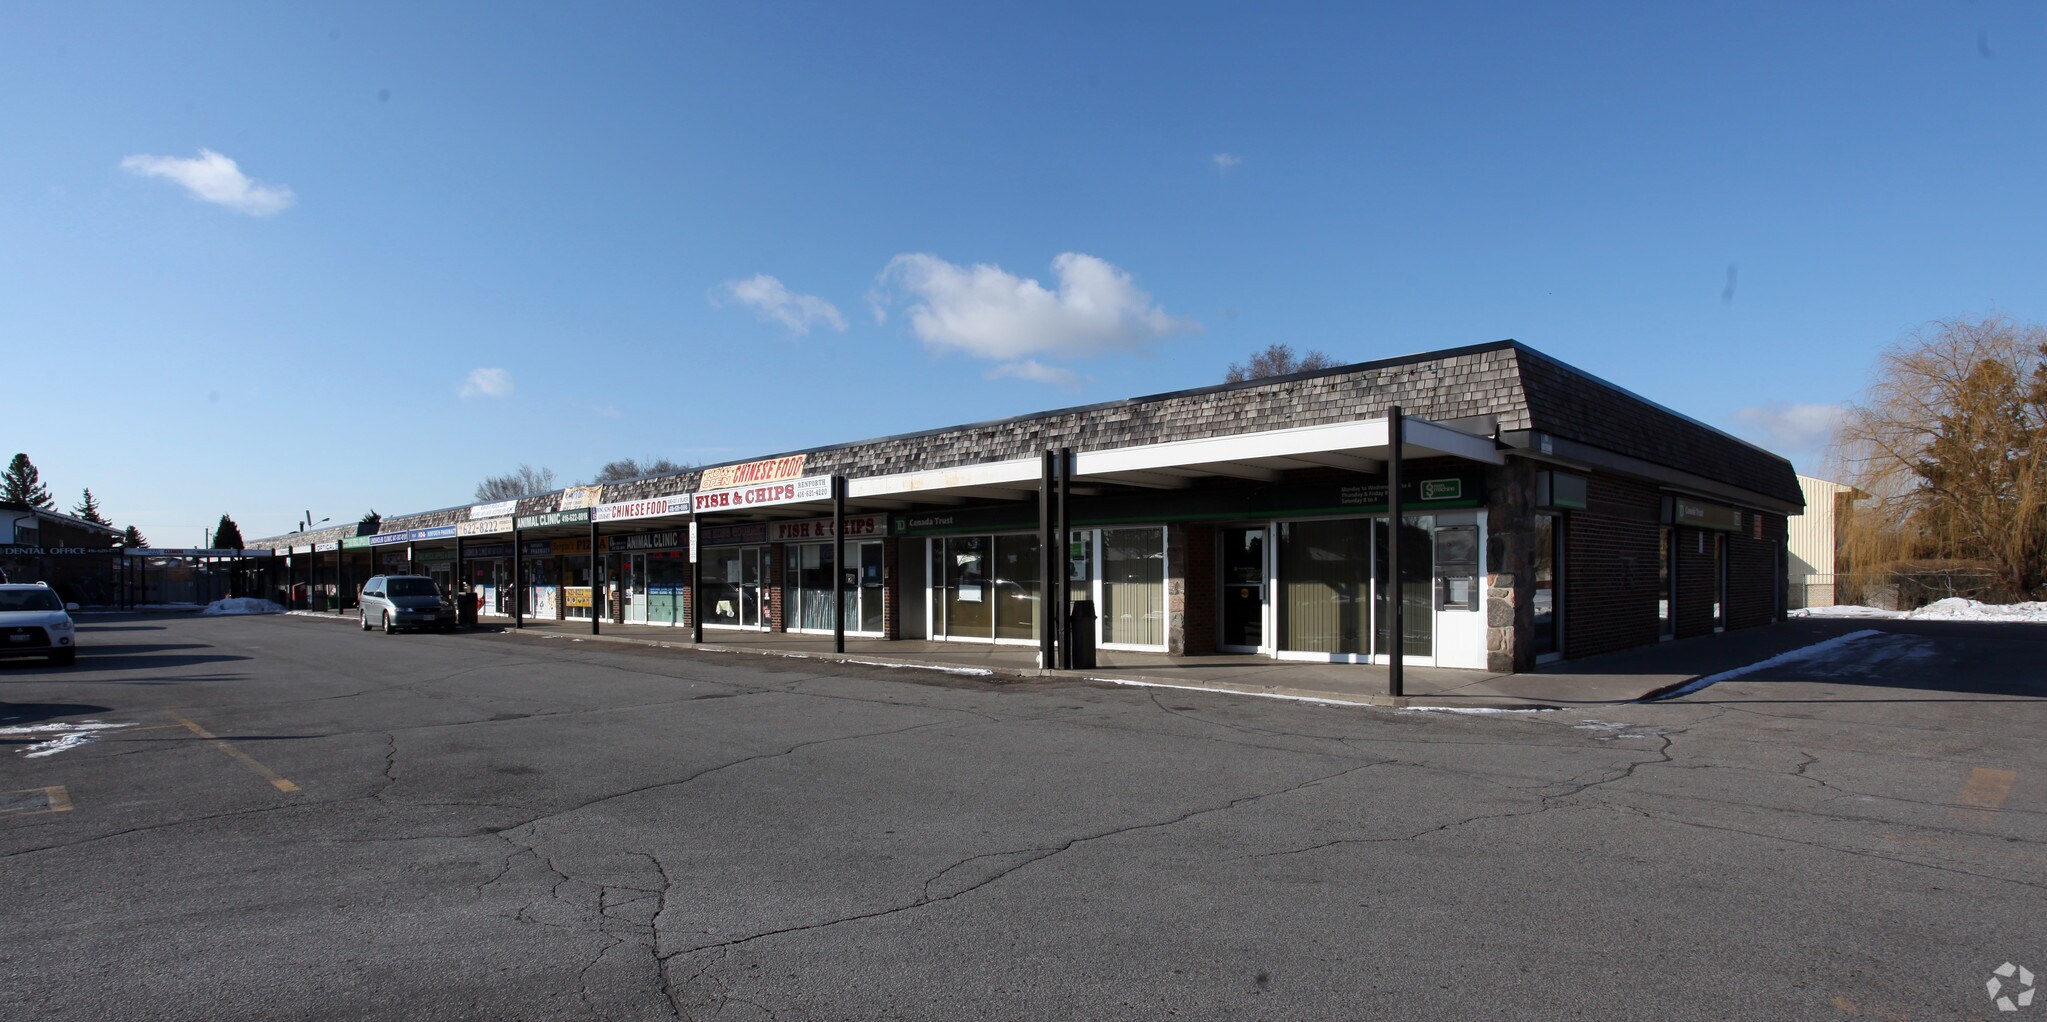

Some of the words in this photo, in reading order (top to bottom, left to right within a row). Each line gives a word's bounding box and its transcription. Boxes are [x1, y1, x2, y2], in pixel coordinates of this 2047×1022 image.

[704, 467, 731, 479] NOW
[733, 460, 776, 484] CHINESE
[775, 456, 804, 479] FOOD
[702, 477, 731, 489] OPEN
[798, 479, 826, 488] RENFORTH
[695, 492, 730, 510] FISH
[732, 491, 742, 506] &
[745, 484, 795, 504] CHIPS
[612, 503, 645, 518] CHINESE
[646, 500, 667, 515] FOOD
[463, 520, 498, 534] 622-8222
[517, 516, 540, 528] ANIMAL
[540, 514, 560, 526] CLINIC
[896, 519, 905, 530] TD
[909, 518, 933, 527] Canada
[935, 516, 953, 525] Trust
[779, 523, 810, 538] FISH
[815, 522, 824, 536] &
[627, 534, 653, 549] ANIMAL
[653, 531, 678, 547] CLINIC
